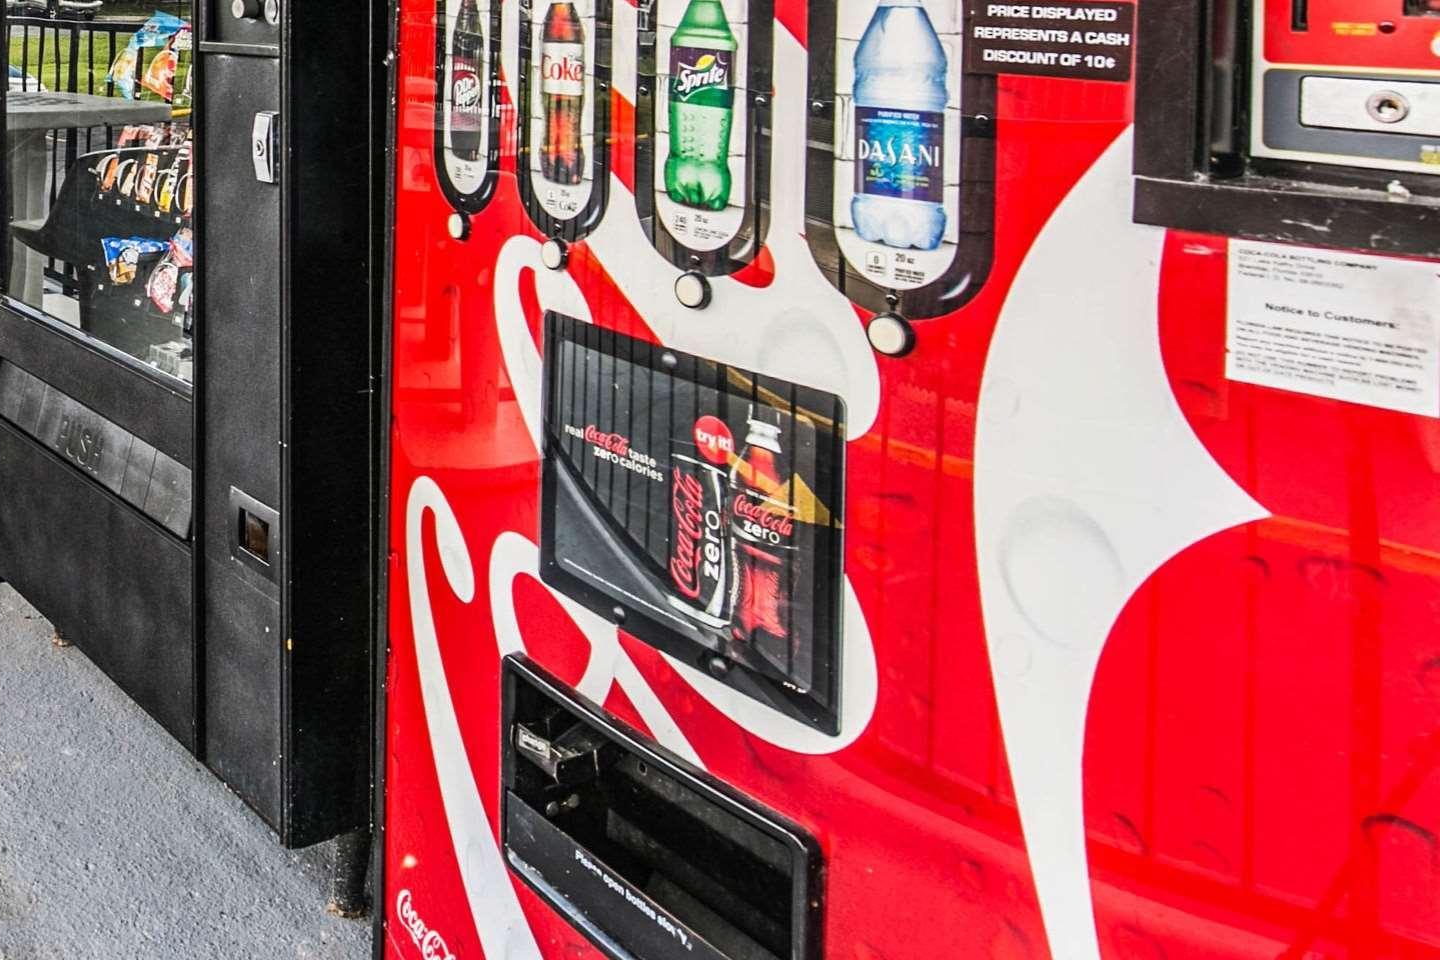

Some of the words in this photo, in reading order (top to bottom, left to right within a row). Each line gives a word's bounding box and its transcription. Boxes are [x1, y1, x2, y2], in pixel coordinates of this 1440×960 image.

[987, 5, 1030, 18] PRICE
[1032, 7, 1117, 22] DISPLAYED
[974, 27, 1068, 42] REPRESENTS
[1070, 31, 1083, 43] A
[1084, 32, 1130, 46] CASH
[542, 54, 584, 82] Coke
[983, 49, 1058, 64] DISCOUNT
[1060, 54, 1081, 66] OF
[1084, 55, 1116, 69] 10¢
[677, 67, 724, 92] Sprite
[859, 136, 939, 167] DASANI
[1265, 302, 1303, 316] Notice
[1308, 309, 1320, 319] to
[1324, 311, 1401, 330] Customers:
[564, 424, 584, 439] real
[628, 448, 656, 469] taste
[695, 427, 717, 449] try
[593, 446, 618, 464] zero
[619, 457, 663, 482] calories
[703, 510, 721, 581] zero
[743, 519, 780, 544] zero
[603, 873, 625, 896] open
[625, 888, 656, 920] bottles
